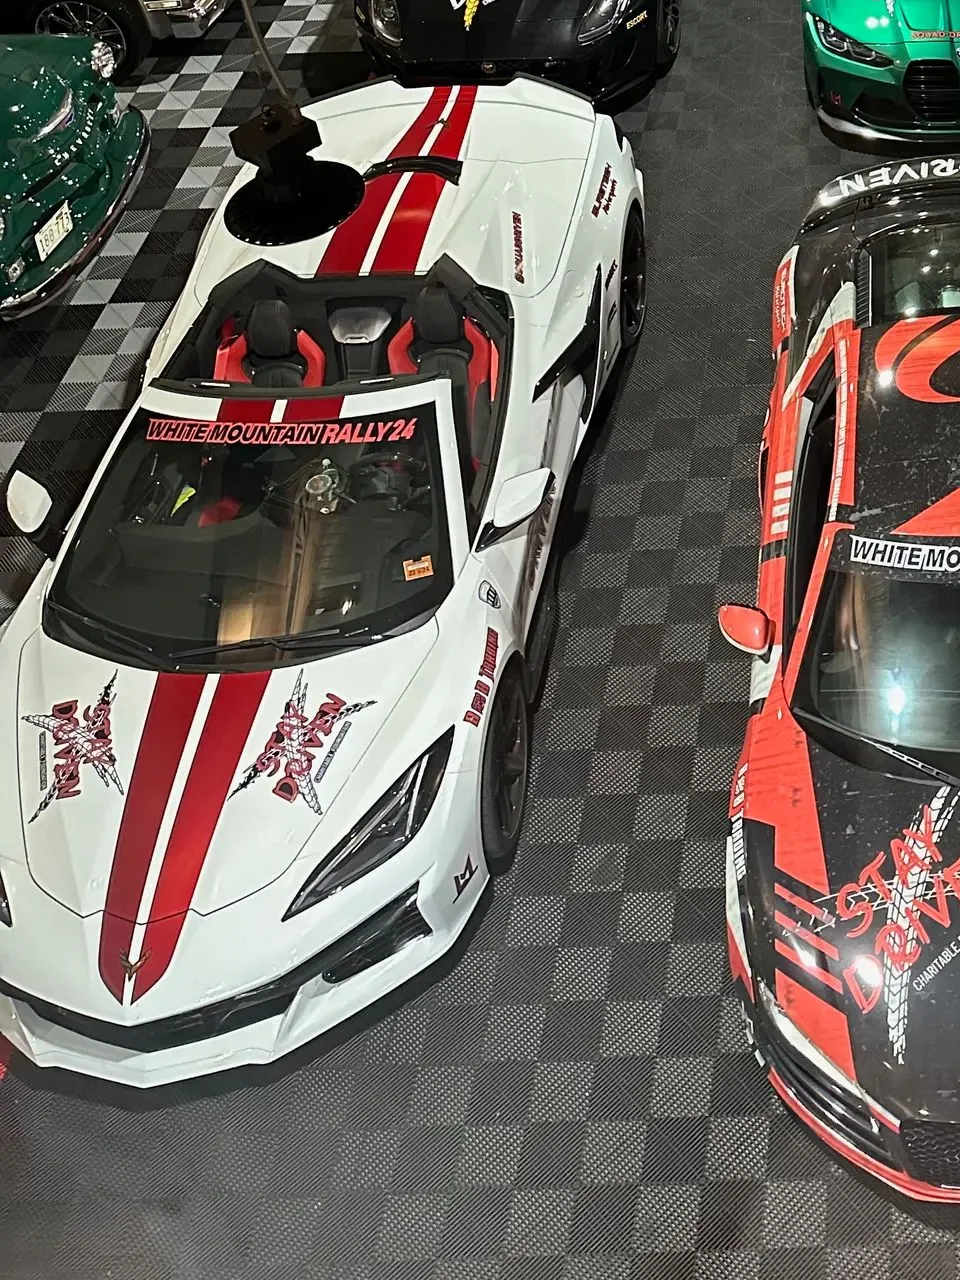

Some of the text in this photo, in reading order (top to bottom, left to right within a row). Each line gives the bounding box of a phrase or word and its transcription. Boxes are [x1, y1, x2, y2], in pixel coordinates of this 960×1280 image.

[625, 10, 649, 30] ESCORT
[146, 417, 417, 445] WHITE MOUNTAIN RALLY24
[850, 535, 924, 570] WHITE
[731, 807, 747, 881] TRADING
[836, 804, 943, 939] STAY
[911, 939, 960, 993] CHARITABLE
